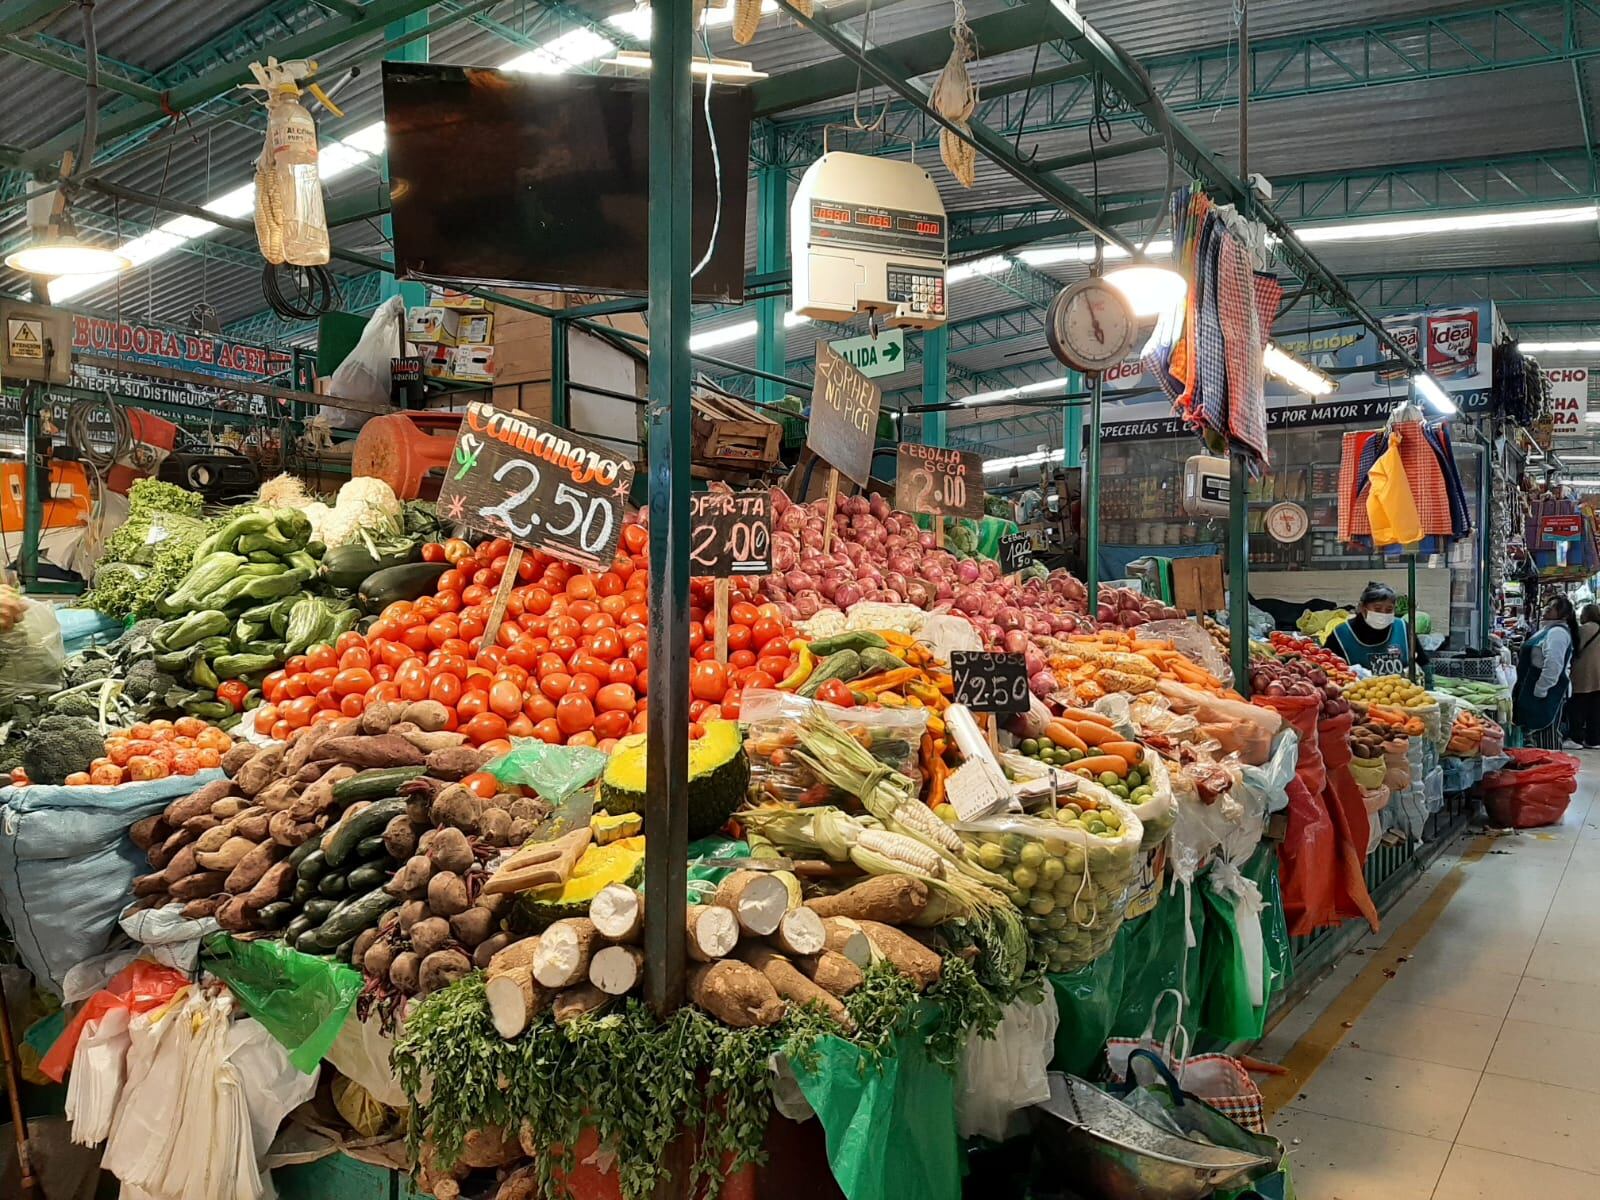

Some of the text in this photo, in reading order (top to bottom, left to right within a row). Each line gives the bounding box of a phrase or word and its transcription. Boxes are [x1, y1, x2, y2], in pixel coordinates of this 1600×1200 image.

[1433, 323, 1473, 345] Ideal
[1447, 341, 1465, 351] Light
[184, 336, 214, 364] DE
[842, 346, 878, 368] ALIDA
[124, 382, 141, 398] SU
[143, 383, 213, 408] DISTINGUID
[825, 380, 869, 434] NO PICA
[1468, 392, 1489, 408] 05
[1100, 419, 1159, 438] SPECERÍAS
[1282, 409, 1306, 423] POR
[1312, 404, 1358, 420] MAYOR
[1363, 403, 1371, 416] Y
[899, 443, 960, 463] CEBOLLA
[911, 468, 966, 515] 2.00
[479, 459, 614, 553] 2.50
[969, 675, 1027, 706] 2.50
